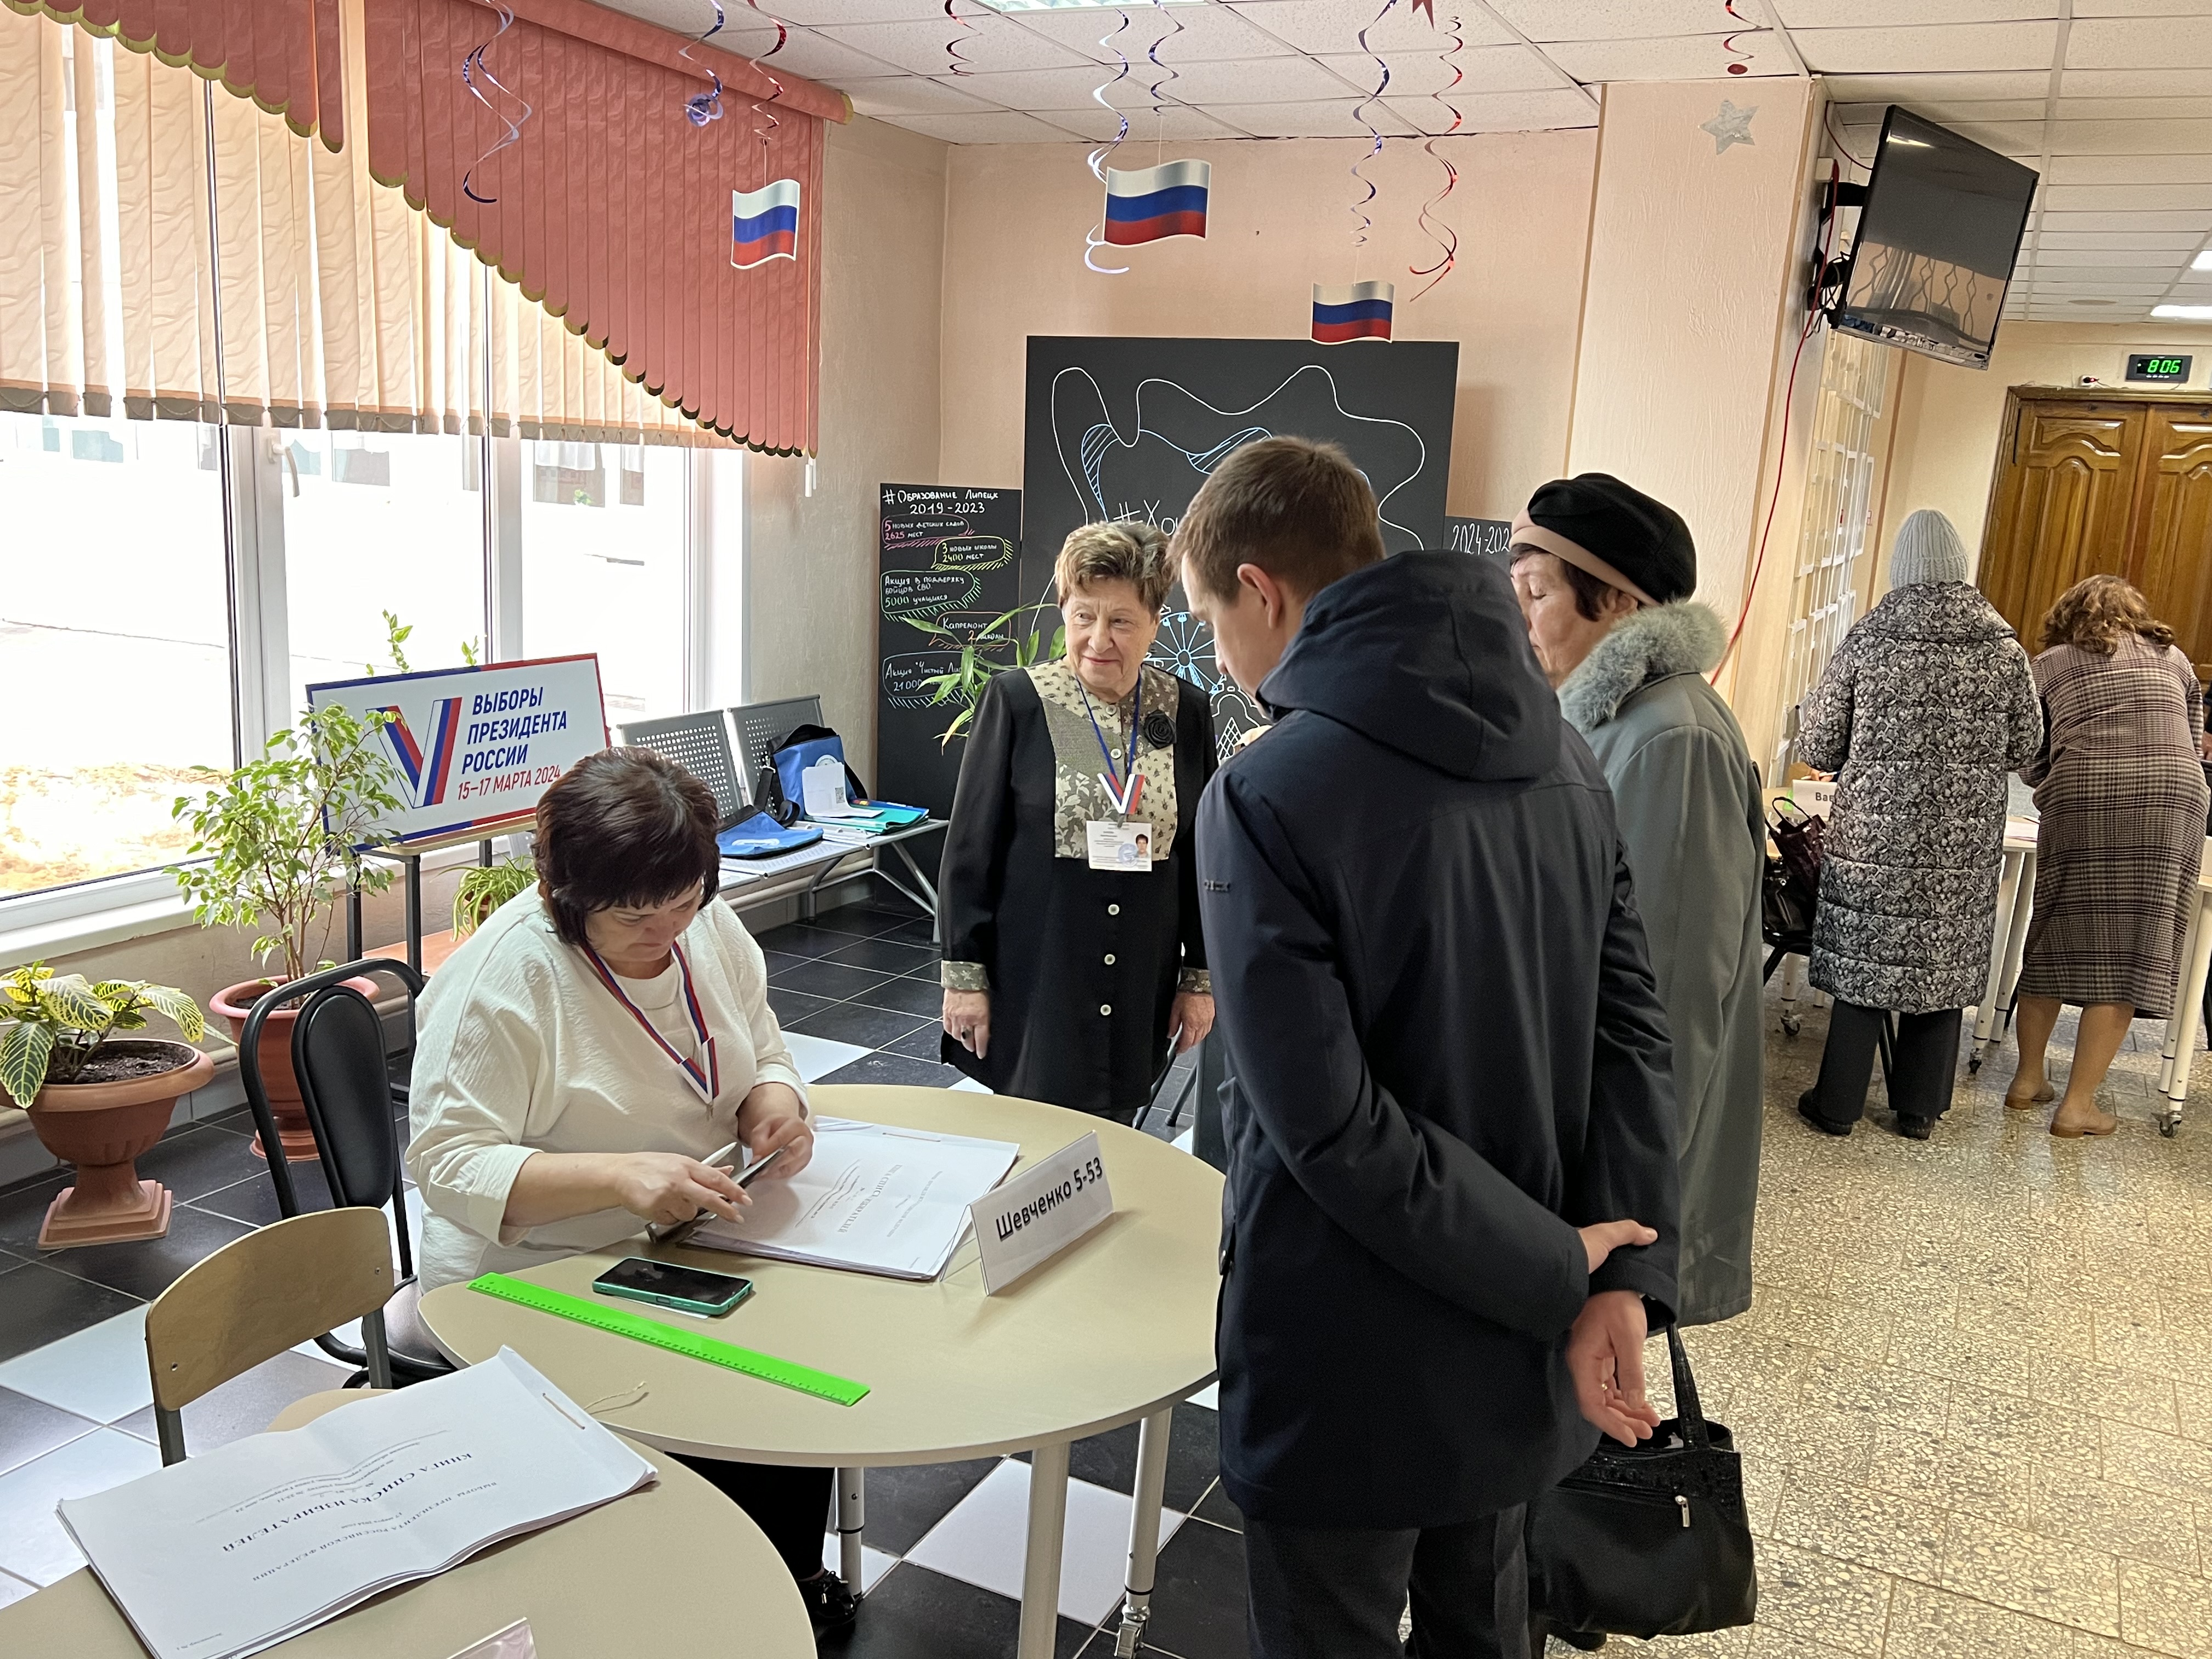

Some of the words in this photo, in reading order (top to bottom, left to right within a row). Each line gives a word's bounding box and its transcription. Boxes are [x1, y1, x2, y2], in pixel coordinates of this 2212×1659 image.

[884, 520, 893, 532] 5
[1113, 499, 1179, 536] #Хо
[885, 532, 905, 541] 2625
[942, 542, 947, 554] 3
[1451, 523, 1510, 555] 2024-202
[943, 554, 963, 563] 2400
[885, 597, 909, 607] 5000
[968, 630, 978, 641] 2
[472, 687, 543, 715] ВЫБОРЫ
[467, 711, 566, 745] ПРЕЗИДЕНТА
[462, 744, 528, 775] РОССИИ
[493, 770, 531, 793] МАРТА
[534, 765, 560, 785] 2024
[996, 1181, 1072, 1242] Шевченко
[1074, 1156, 1103, 1193] 5-53
[419, 1453, 472, 1472] КНИГА
[349, 1472, 415, 1504] СПИСКА
[457, 1482, 496, 1497] ВЫБОРЫ
[222, 1500, 346, 1552] ИЗБИРАТЕЛЕЙ
[391, 1497, 452, 1531] ПРЕЗИДЕНТА
[319, 1528, 388, 1550] РОССИЙСКОЙ
[252, 1549, 317, 1581] ФЕДЕРАЦИИ
